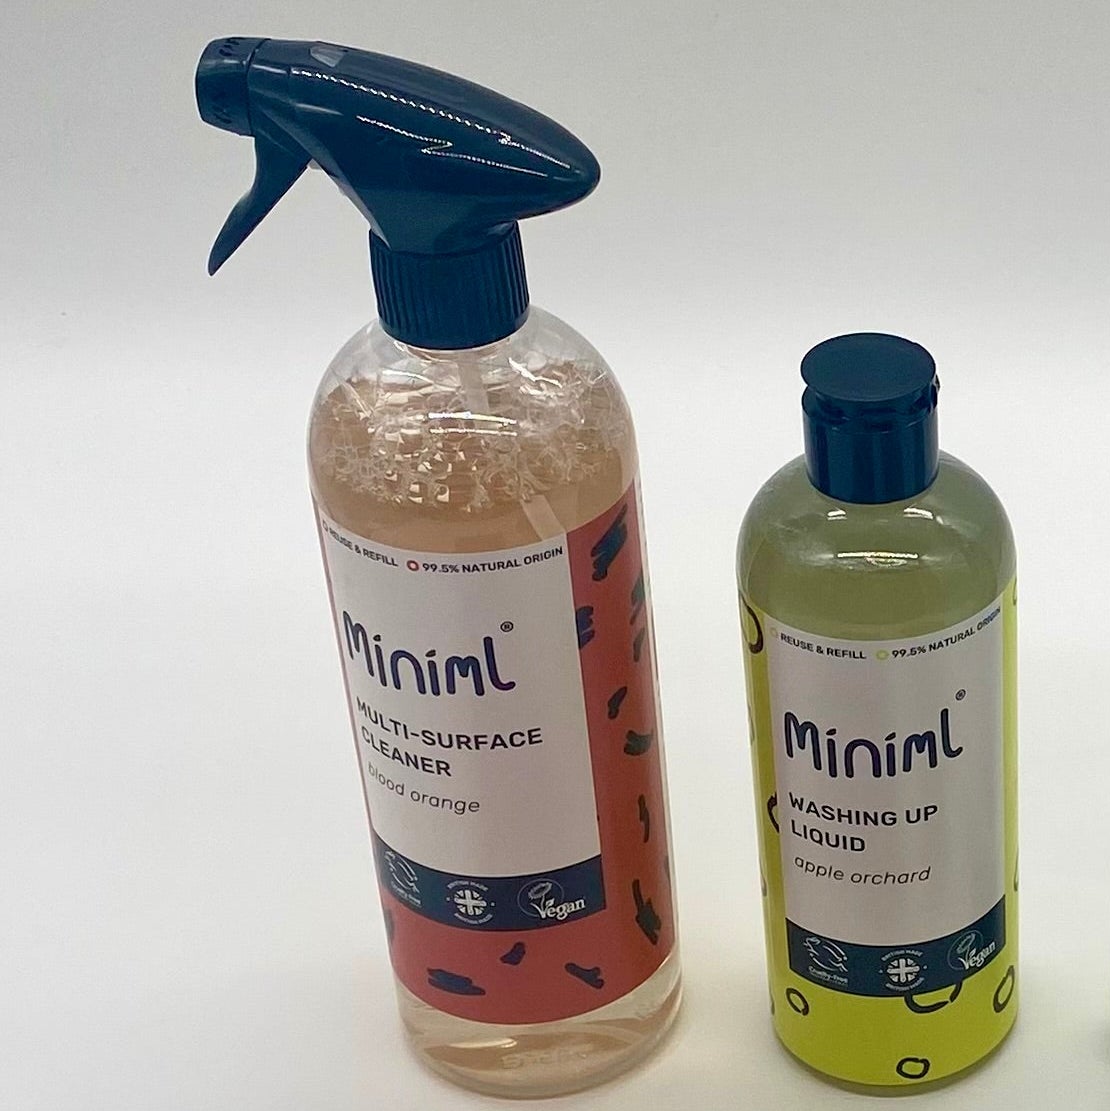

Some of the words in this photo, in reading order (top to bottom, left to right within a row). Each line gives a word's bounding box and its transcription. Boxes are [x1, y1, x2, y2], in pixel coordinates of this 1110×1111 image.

[363, 548, 398, 568] REFILL
[422, 561, 459, 575] 99.5%
[462, 559, 521, 574] NATURAL
[523, 546, 563, 565] ORIGIN
[342, 609, 516, 697] Miniml
[780, 632, 814, 652] REUSE
[816, 645, 824, 655] &
[826, 647, 866, 660] REFILL
[892, 645, 926, 659] 99.5%
[928, 627, 976, 653] NATURAL
[356, 696, 544, 752] MULTI-SURFACE
[361, 726, 452, 778] CLEANER
[783, 708, 964, 778] Miniml
[368, 762, 405, 798] blood
[410, 788, 480, 816] orange
[789, 791, 897, 827] WASHING
[905, 804, 938, 825] UP
[791, 819, 866, 853] LIQUID
[794, 855, 844, 882] apple
[850, 866, 932, 885] orchard
[530, 897, 586, 920] Vegan
[958, 941, 996, 971] Vegan
